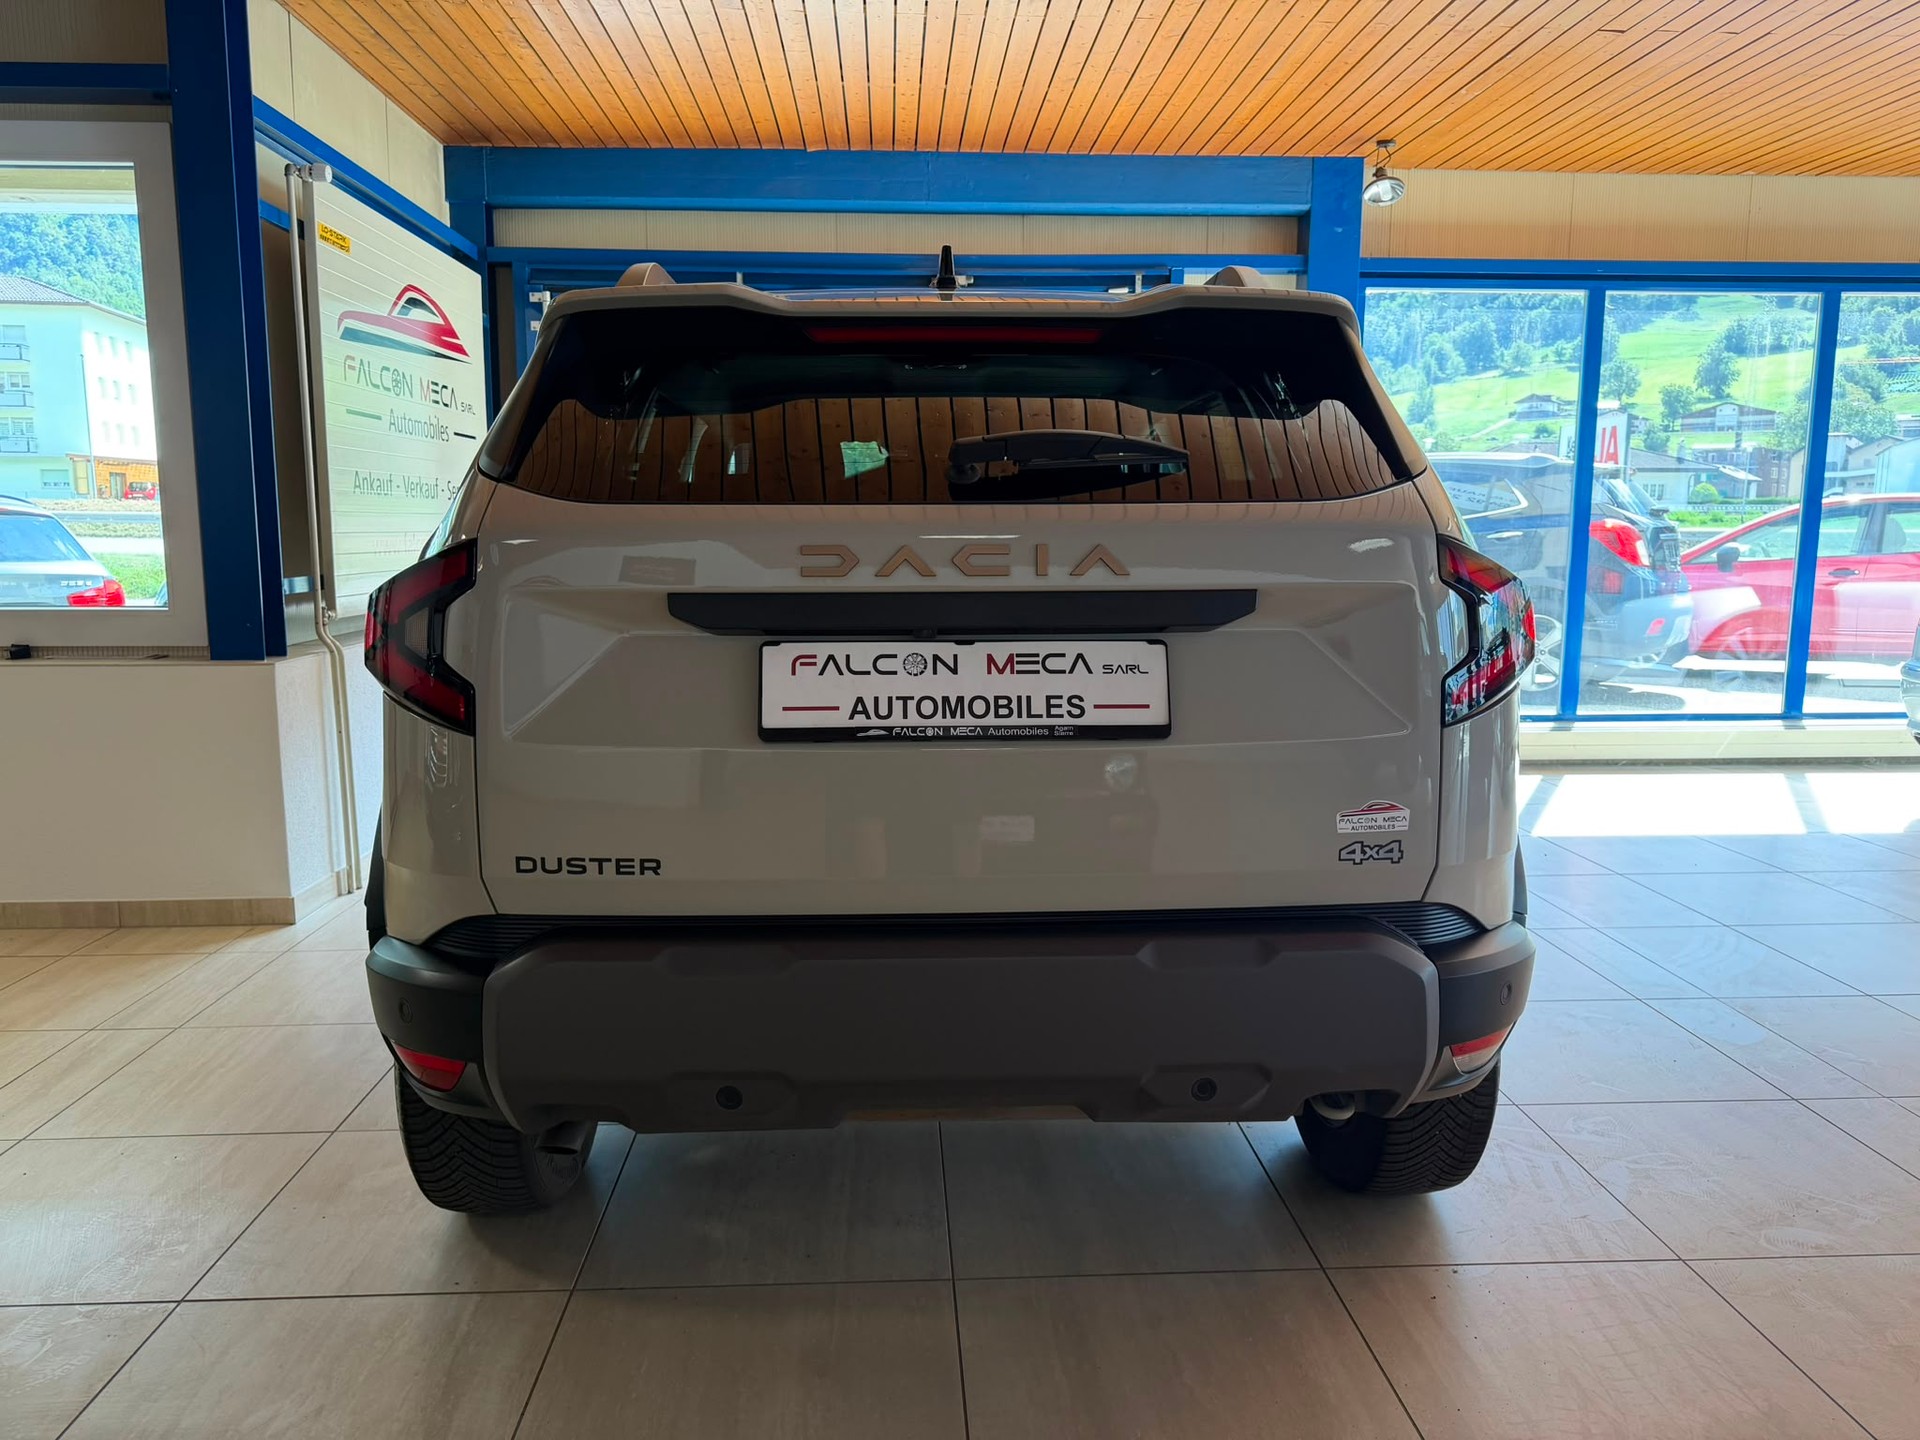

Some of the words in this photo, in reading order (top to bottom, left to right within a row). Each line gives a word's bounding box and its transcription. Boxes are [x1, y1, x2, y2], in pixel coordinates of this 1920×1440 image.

[343, 354, 414, 399] FALCON
[419, 376, 459, 411] MECA
[388, 408, 450, 442] Automobiles
[353, 470, 394, 496] Ankauf
[402, 475, 439, 500] Verkauf
[799, 544, 1131, 577] DACIA
[790, 653, 959, 677] FALCON
[986, 653, 1094, 675] MECA
[1102, 664, 1150, 675] SARL
[847, 694, 1087, 721] AUTOMOBILES
[892, 727, 944, 737] FALCON
[950, 727, 983, 736] MECA
[987, 726, 1050, 737] Automobiles
[515, 856, 661, 876] DUSTER
[1338, 840, 1403, 865] 4x4
